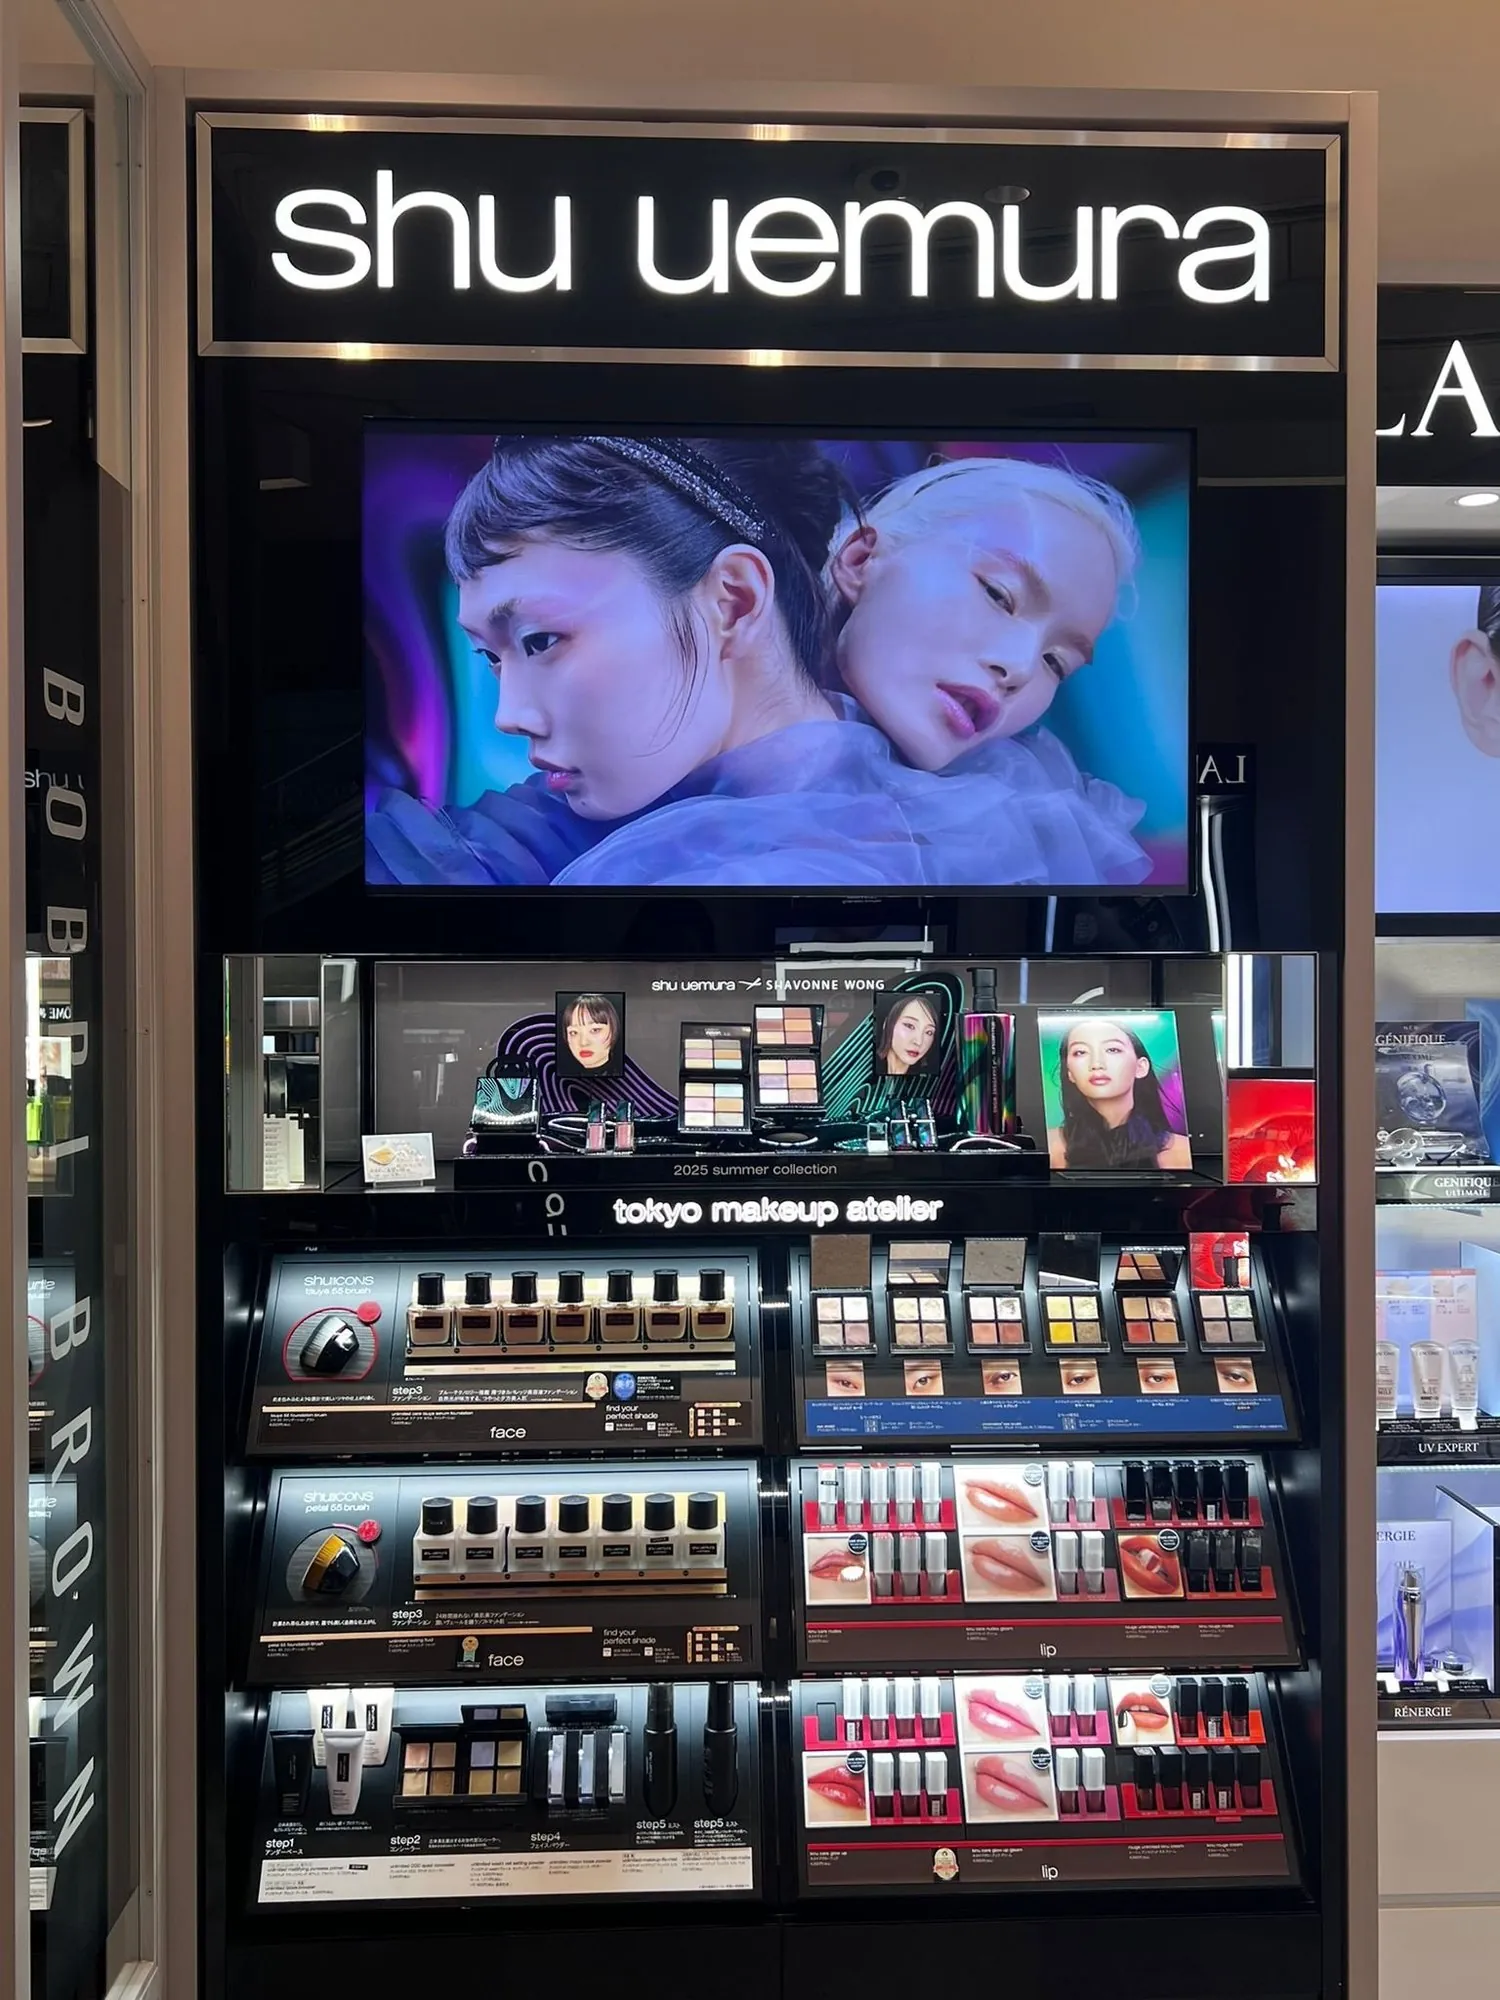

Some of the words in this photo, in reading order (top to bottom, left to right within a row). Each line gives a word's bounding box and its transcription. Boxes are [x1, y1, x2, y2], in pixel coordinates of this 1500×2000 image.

[271, 169, 573, 293] shu
[637, 195, 1270, 306] uemura
[652, 979, 677, 991] shu
[681, 979, 736, 991] uemura
[766, 979, 838, 991] SHAVONNE
[844, 979, 885, 991] WONG
[673, 1164, 709, 1176] 2025
[713, 1165, 767, 1176] summer
[773, 1163, 838, 1176] collection
[612, 1197, 702, 1228] tokyo
[710, 1195, 839, 1228] makeup
[845, 1195, 944, 1222] atelier
[392, 1385, 423, 1397] step3
[606, 1404, 620, 1412] find
[621, 1405, 639, 1413] your
[605, 1411, 633, 1421] perfect
[490, 1426, 527, 1439] face
[1418, 1443, 1435, 1453] UV
[1437, 1442, 1479, 1452] EXPERT
[305, 1503, 329, 1513] petal
[344, 1503, 370, 1512] brush
[51, 1296, 95, 1860] BROWN
[392, 1609, 423, 1622] step3
[603, 1628, 618, 1636] find
[618, 1629, 637, 1637] your
[603, 1636, 632, 1645] perfect
[1040, 1643, 1057, 1658] lip
[487, 1653, 525, 1667] face
[1394, 1702, 1452, 1717] RÉNERGIE
[636, 1819, 666, 1831] step5
[694, 1818, 724, 1830] step5
[265, 1838, 295, 1849] step1
[390, 1835, 421, 1846] step2
[530, 1832, 561, 1843] step4
[1041, 1864, 1059, 1880] lip
